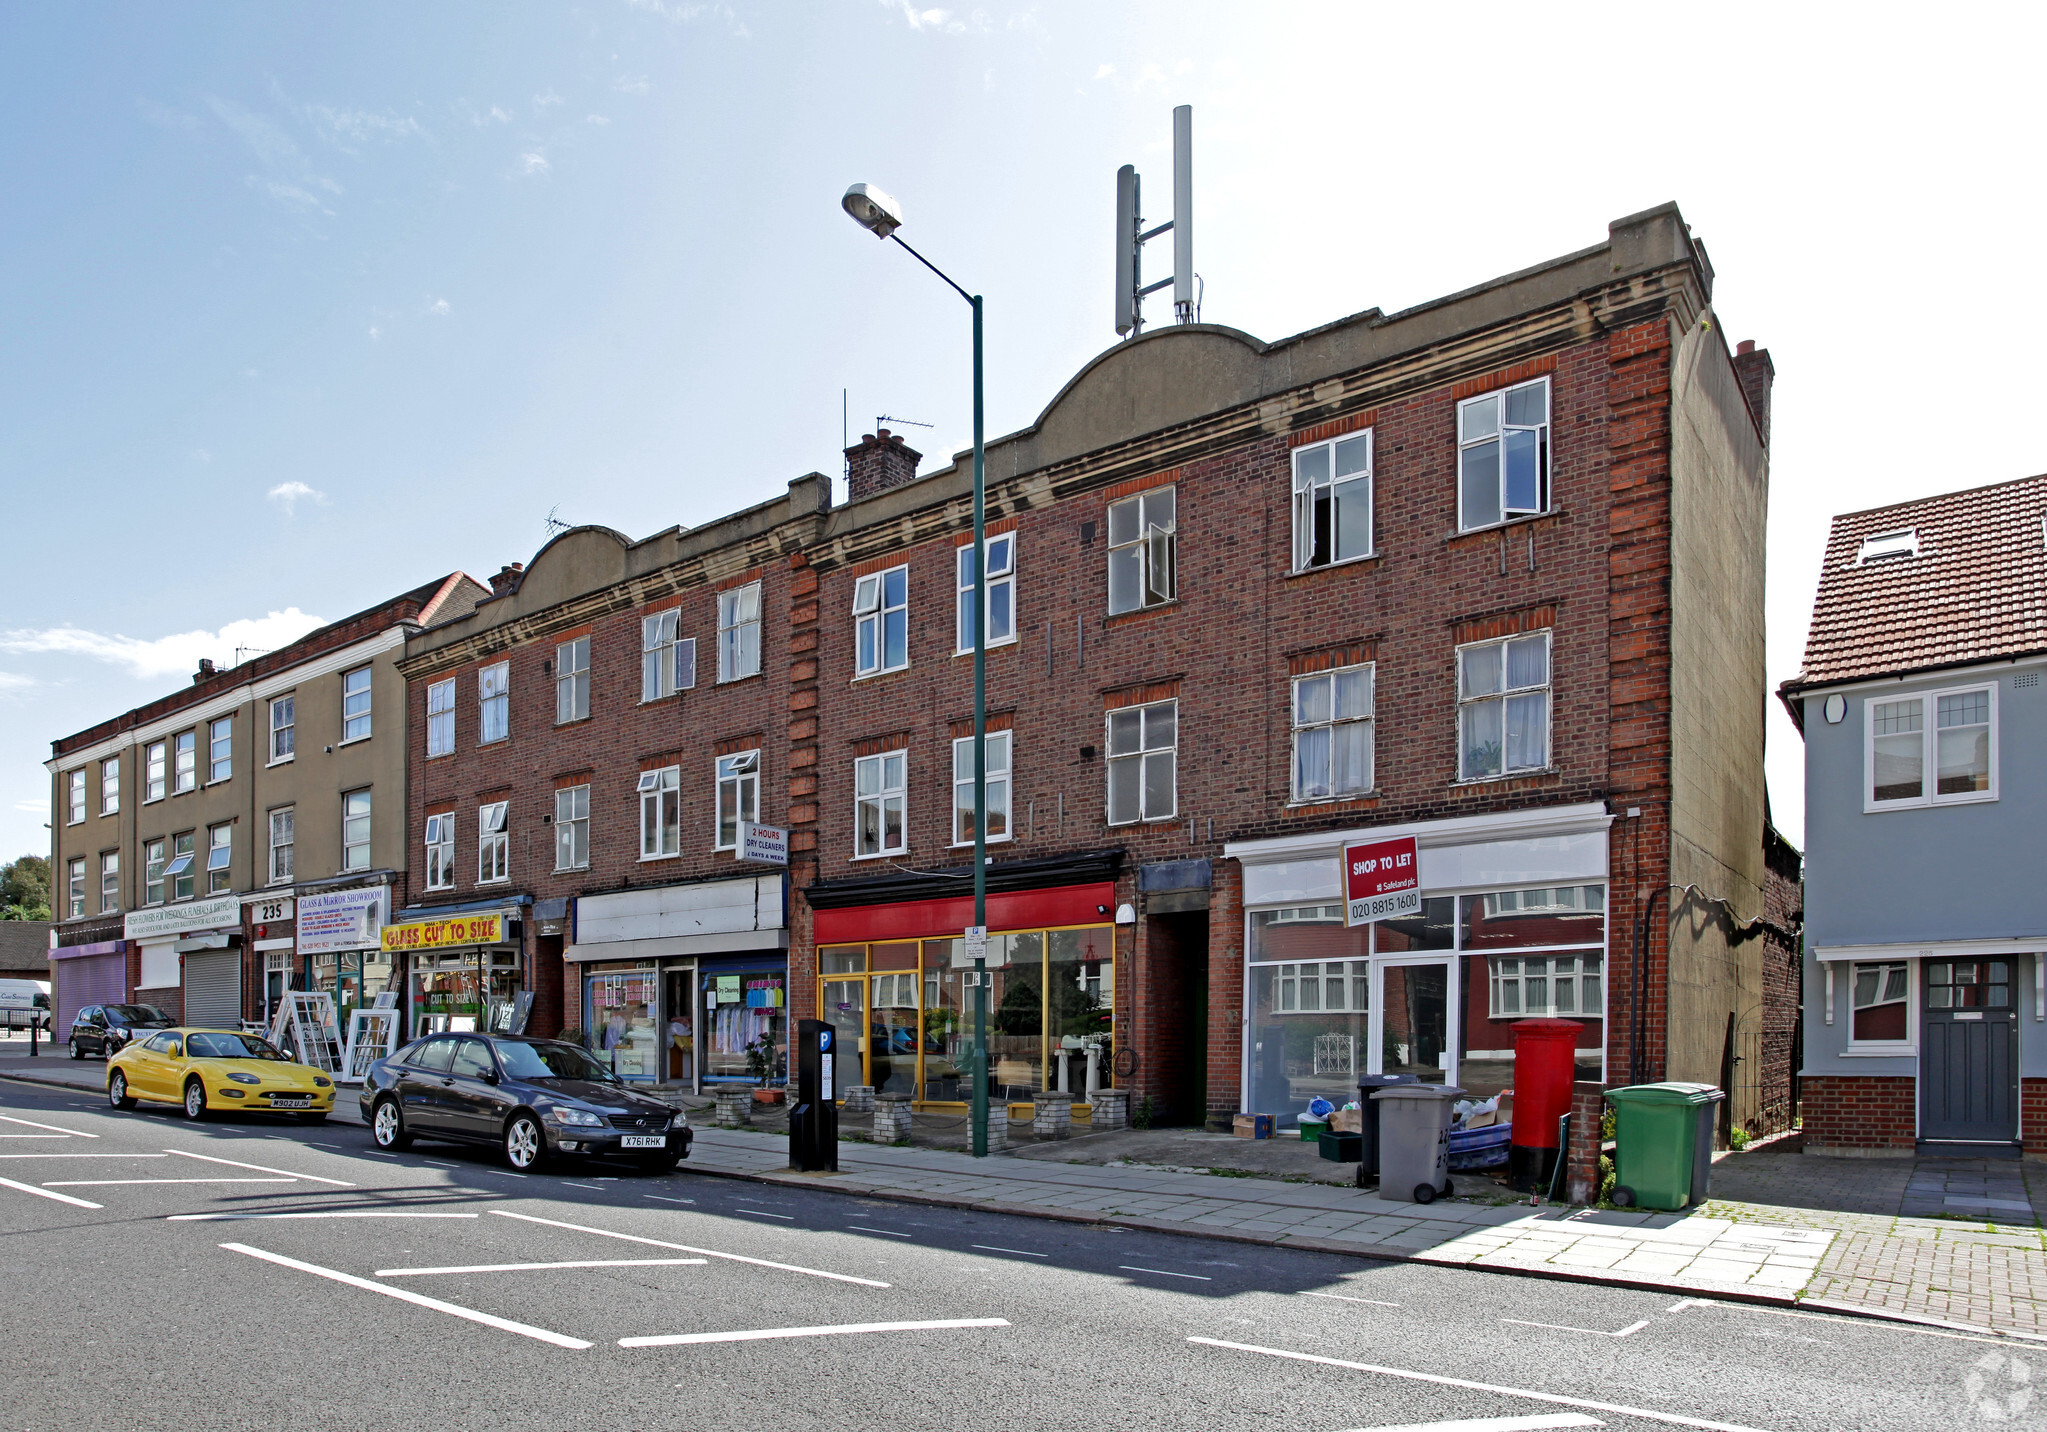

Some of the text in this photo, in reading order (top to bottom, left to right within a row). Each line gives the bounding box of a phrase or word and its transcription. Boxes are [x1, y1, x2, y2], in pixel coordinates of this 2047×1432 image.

[753, 828, 780, 840] 2 HOURS
[759, 841, 785, 852] CLEANERS
[1353, 853, 1411, 876] SHOP TO LET
[1383, 878, 1407, 890] Safeland
[300, 890, 382, 909] GLASS & MIRROR SHOWROOM
[1353, 894, 1416, 918] 020 8815 1600
[263, 904, 282, 920] 235
[387, 920, 494, 946] GLASS CUT TO SIZE
[431, 994, 443, 1004] CUT
[445, 994, 453, 1004] TO
[821, 1032, 828, 1047] P
[626, 1137, 660, 1146] X761 RHK
